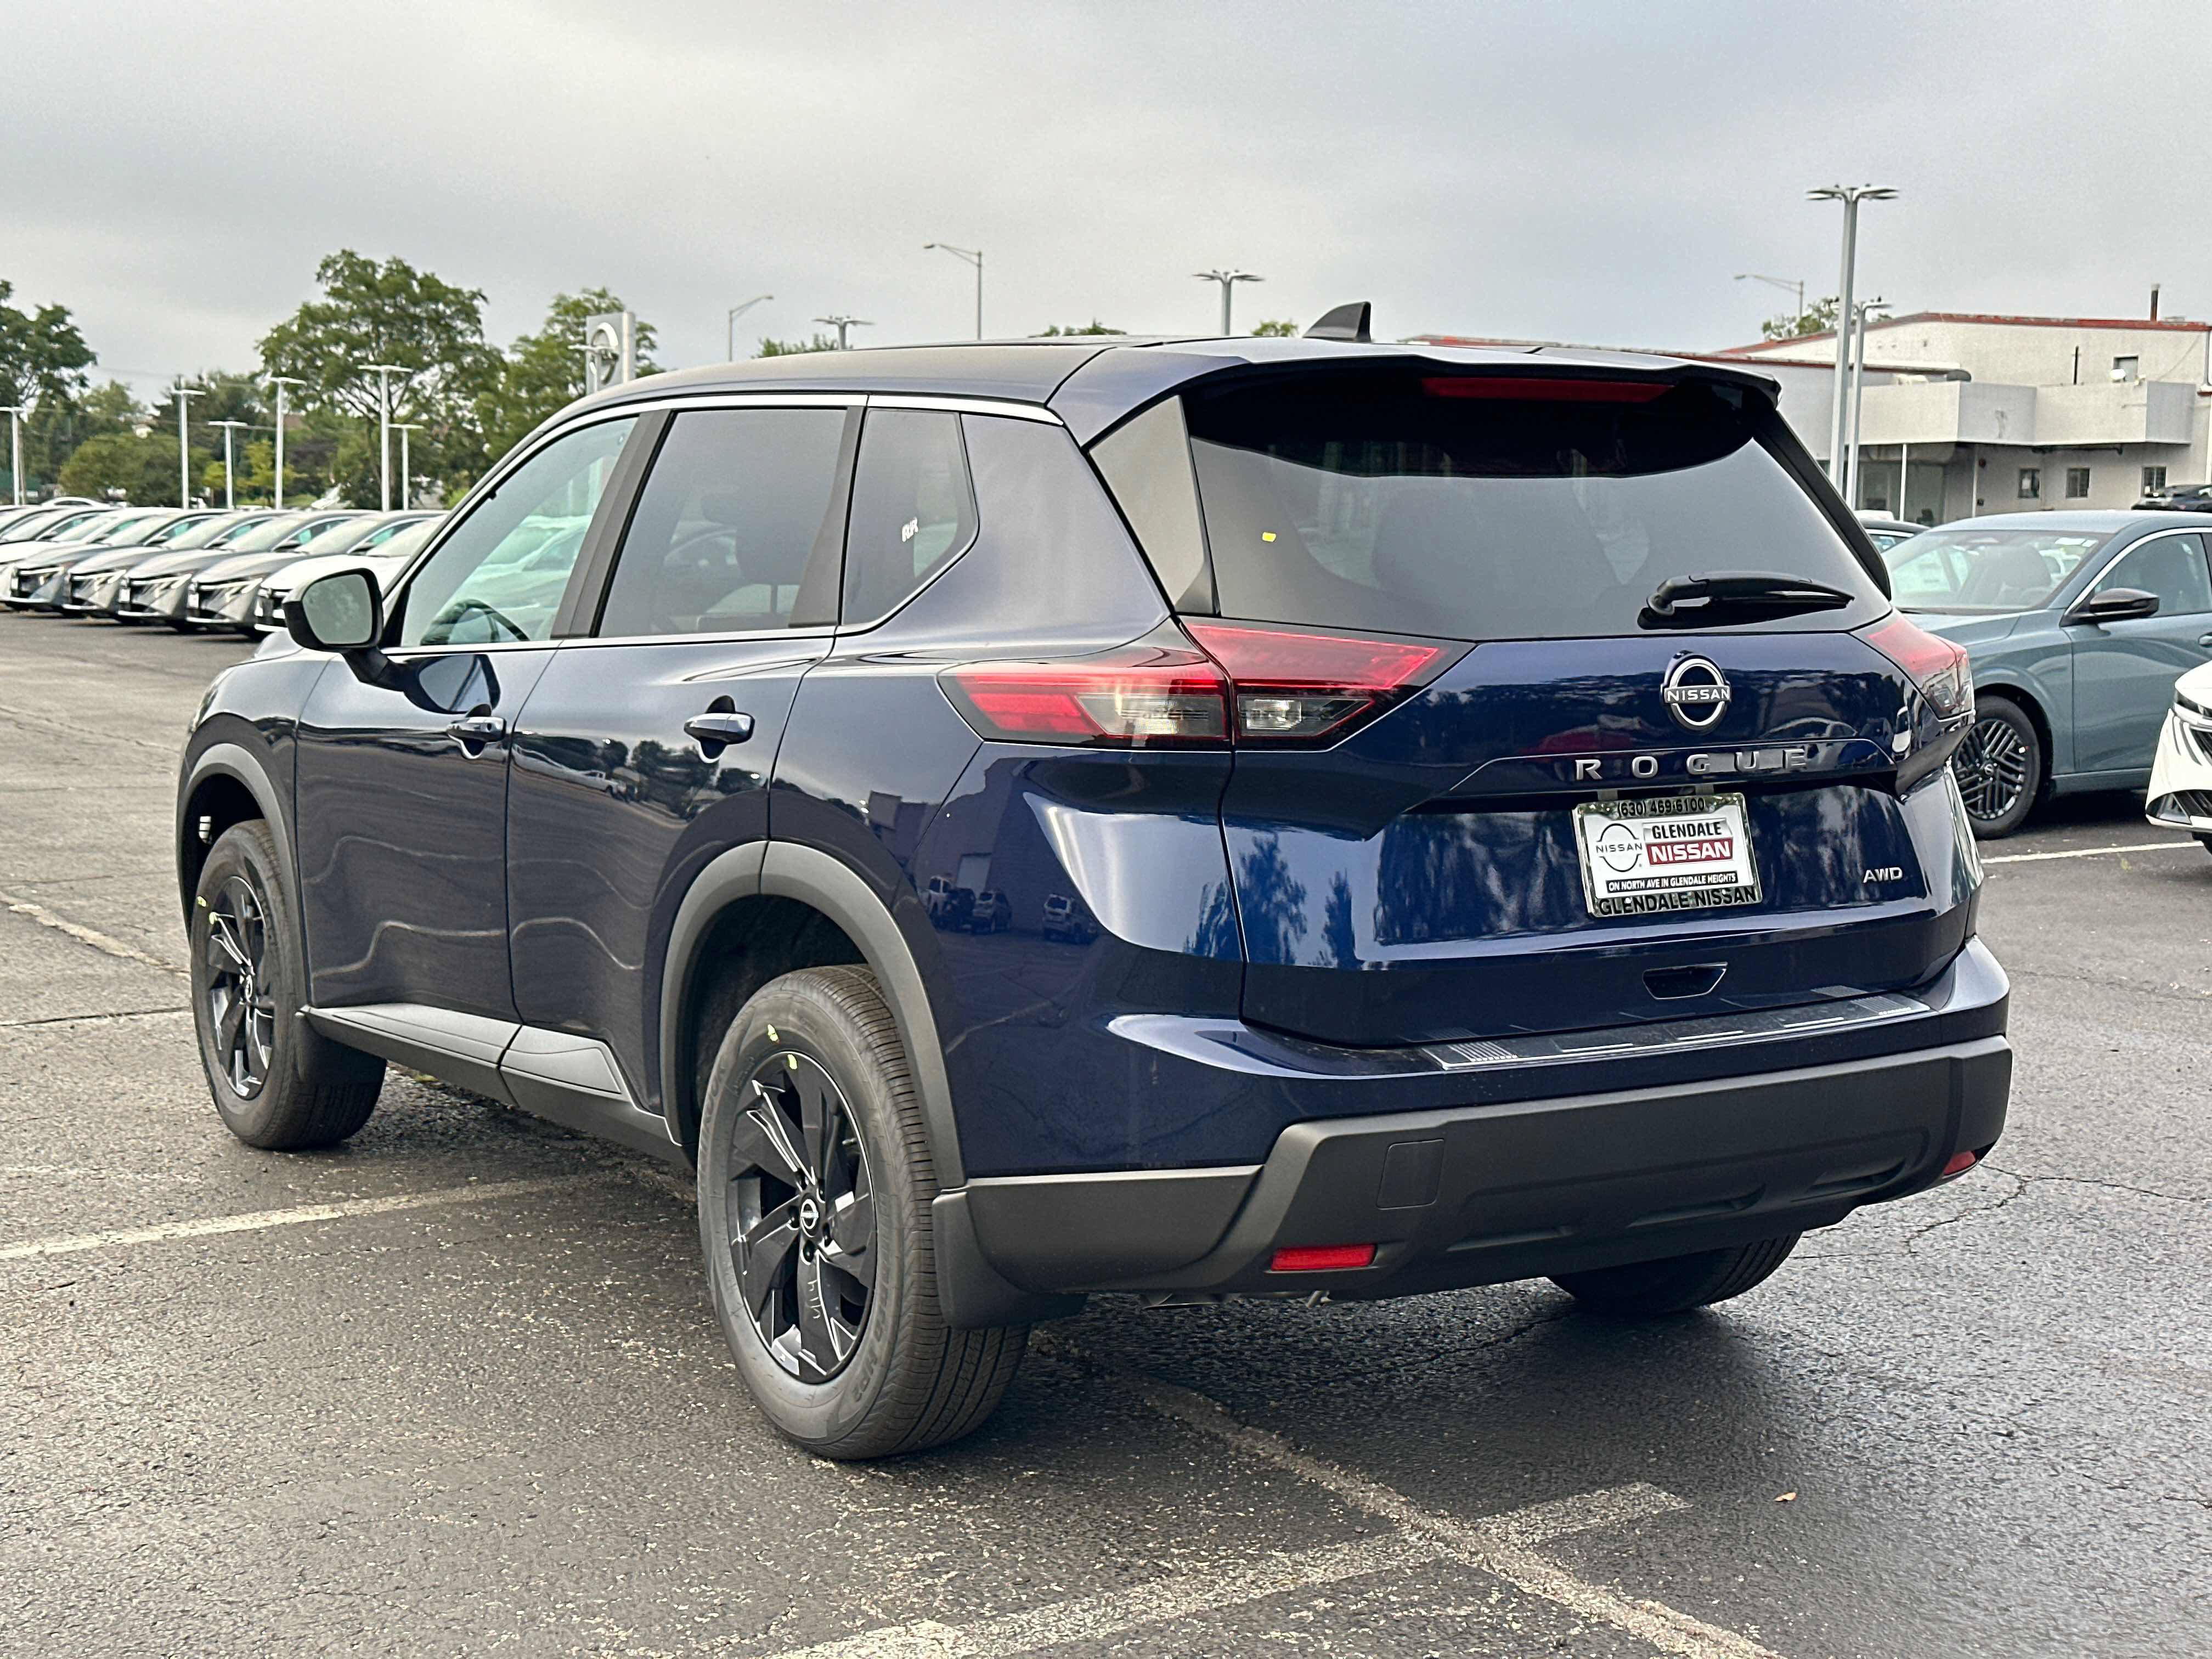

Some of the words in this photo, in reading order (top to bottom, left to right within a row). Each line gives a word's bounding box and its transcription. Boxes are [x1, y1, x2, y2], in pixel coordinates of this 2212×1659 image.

[1667, 687, 1730, 702] NISSAN
[1575, 748, 1806, 780] ROGUE
[1617, 800, 1646, 817] (630)
[1652, 822, 1722, 839] GLENDALE
[1596, 843, 1643, 854] NISSAN
[1651, 840, 1731, 863] NISSAN
[1609, 882, 1620, 891] ON
[1621, 880, 1645, 890] NORTH
[1646, 879, 1660, 888] AVE
[1661, 878, 1668, 888] IN
[1671, 875, 1706, 887] GLENDALE
[1708, 872, 1736, 884] HEIGHTS
[1863, 867, 1903, 884] AWD
[1599, 894, 1690, 916] GLENDALE
[1695, 887, 1756, 906] NISSAN
